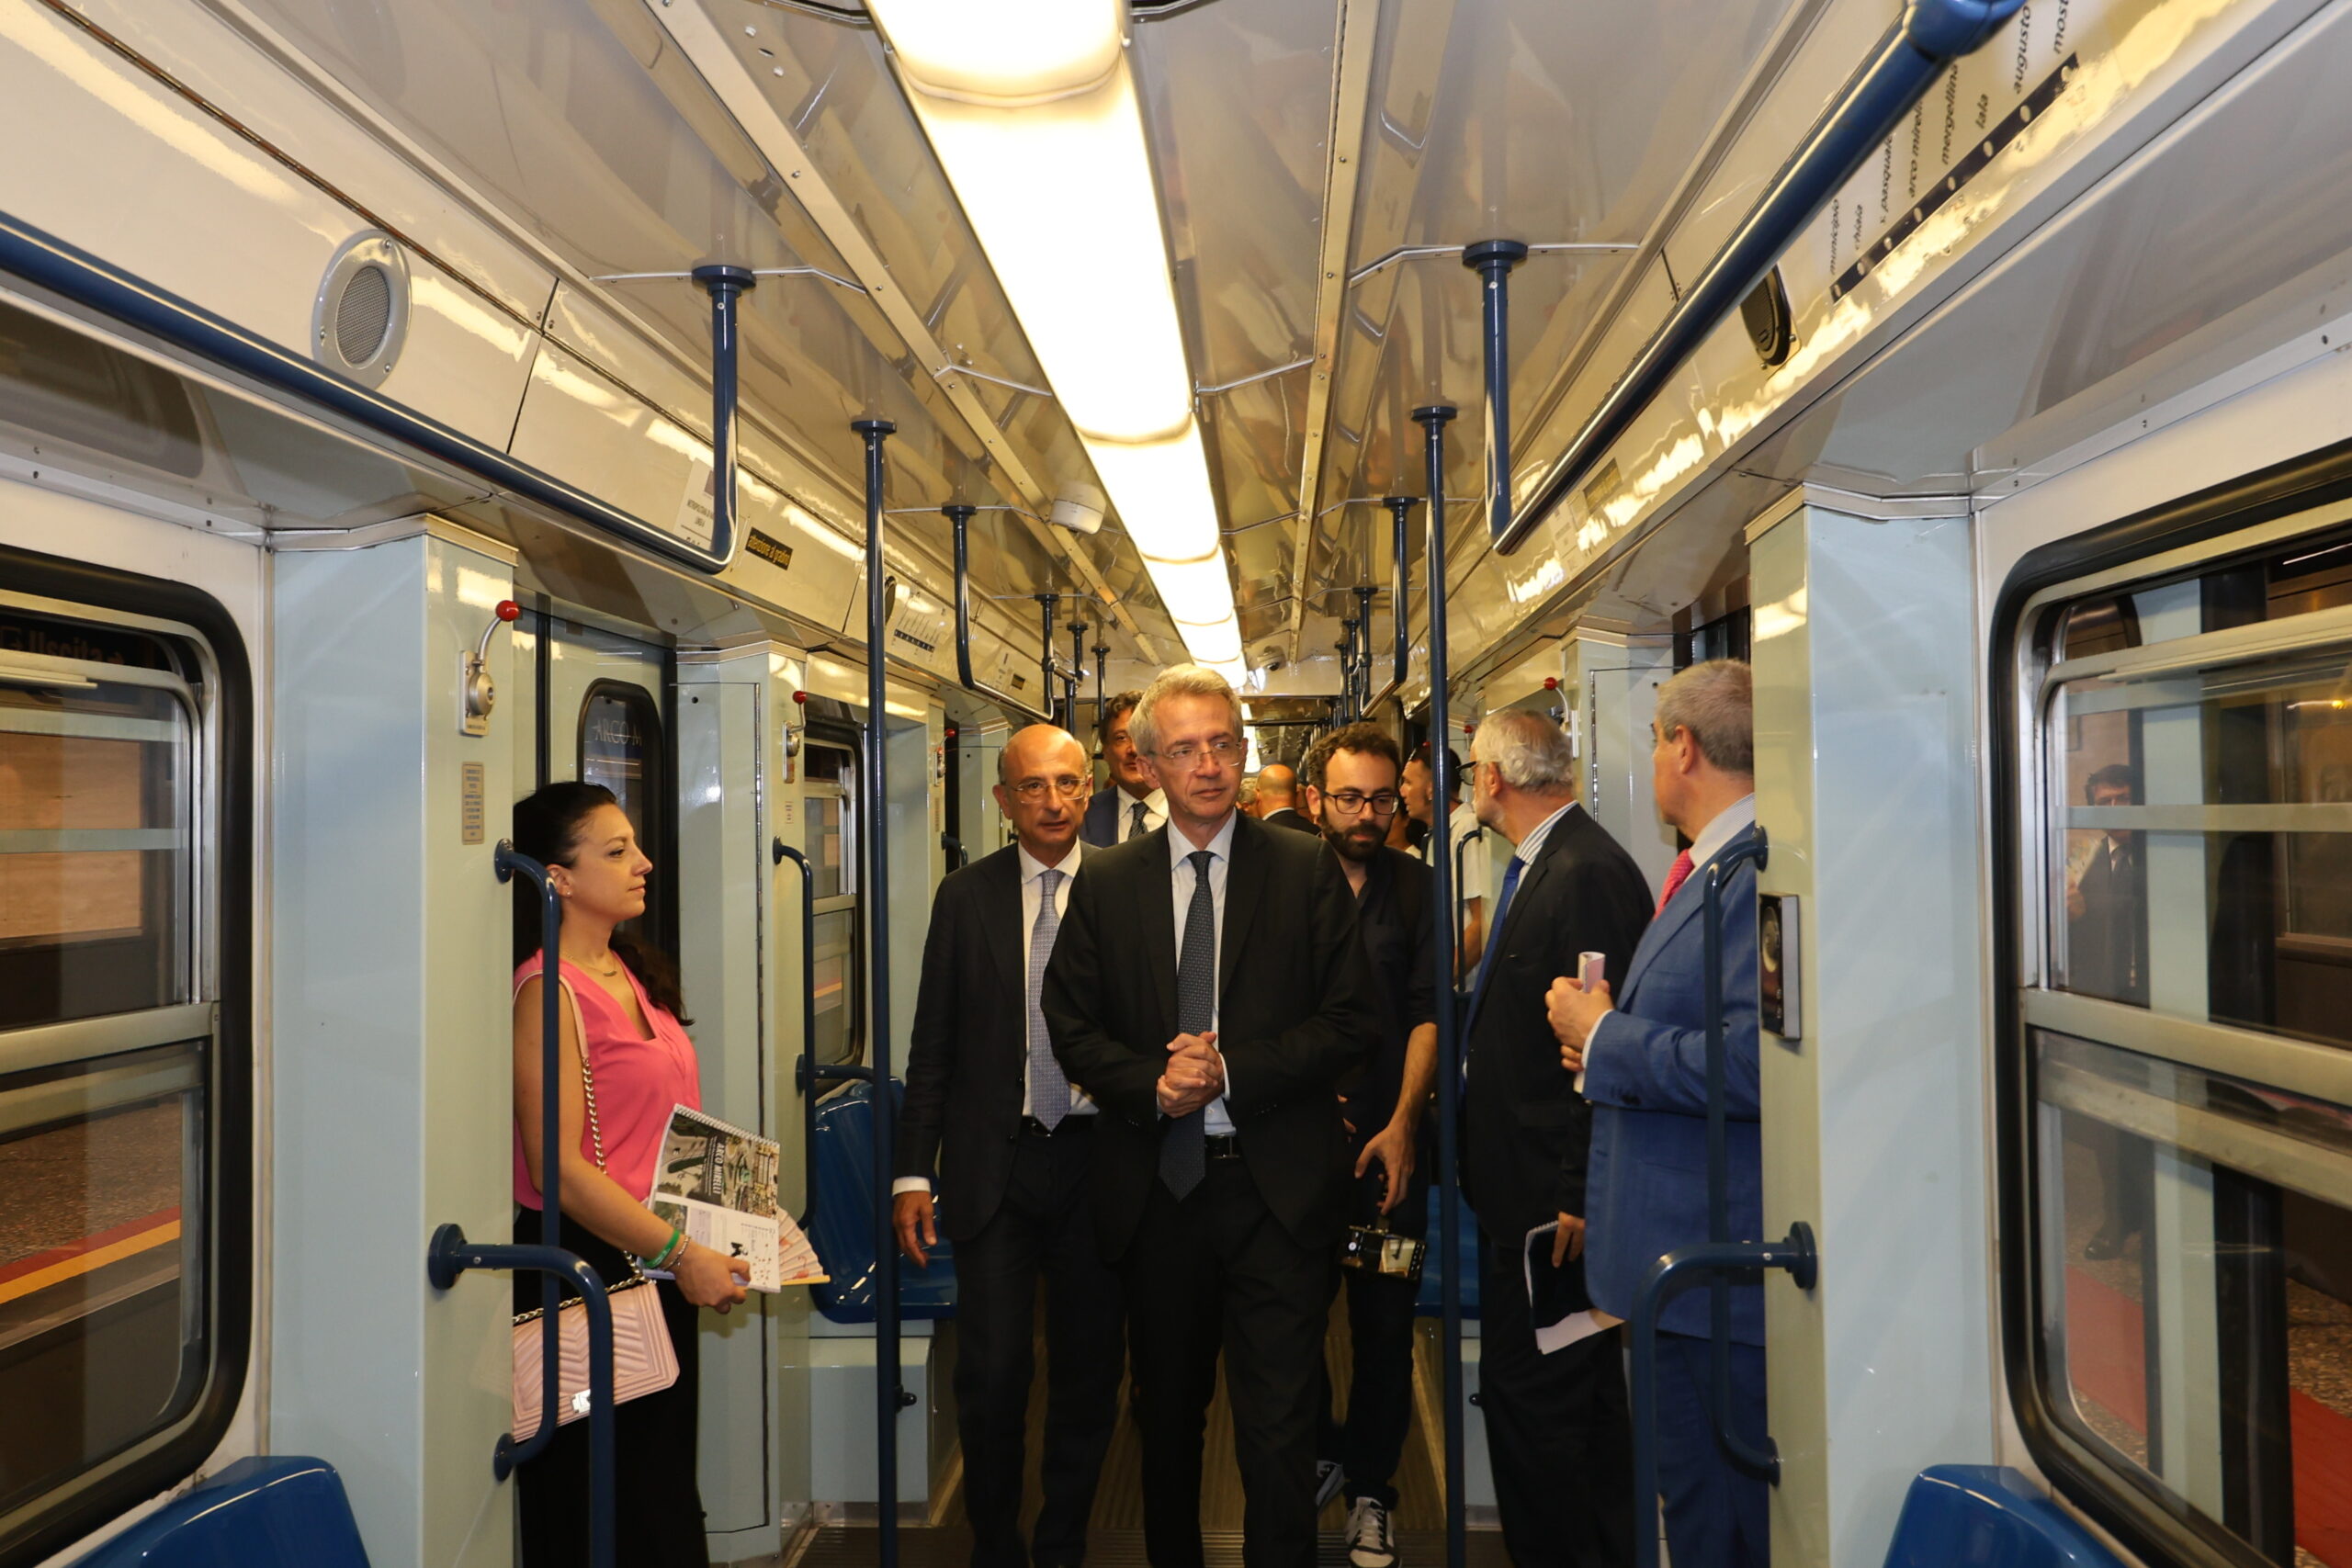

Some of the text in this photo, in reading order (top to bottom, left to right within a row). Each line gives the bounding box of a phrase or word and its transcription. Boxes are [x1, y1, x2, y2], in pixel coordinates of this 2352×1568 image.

[2014, 5, 2031, 95] augusto
[1941, 63, 1959, 165] mergellina
[1975, 93, 1989, 130] lala
[1908, 159, 1918, 197] arco
[712, 1142, 725, 1194] ARCO MIRELLI
